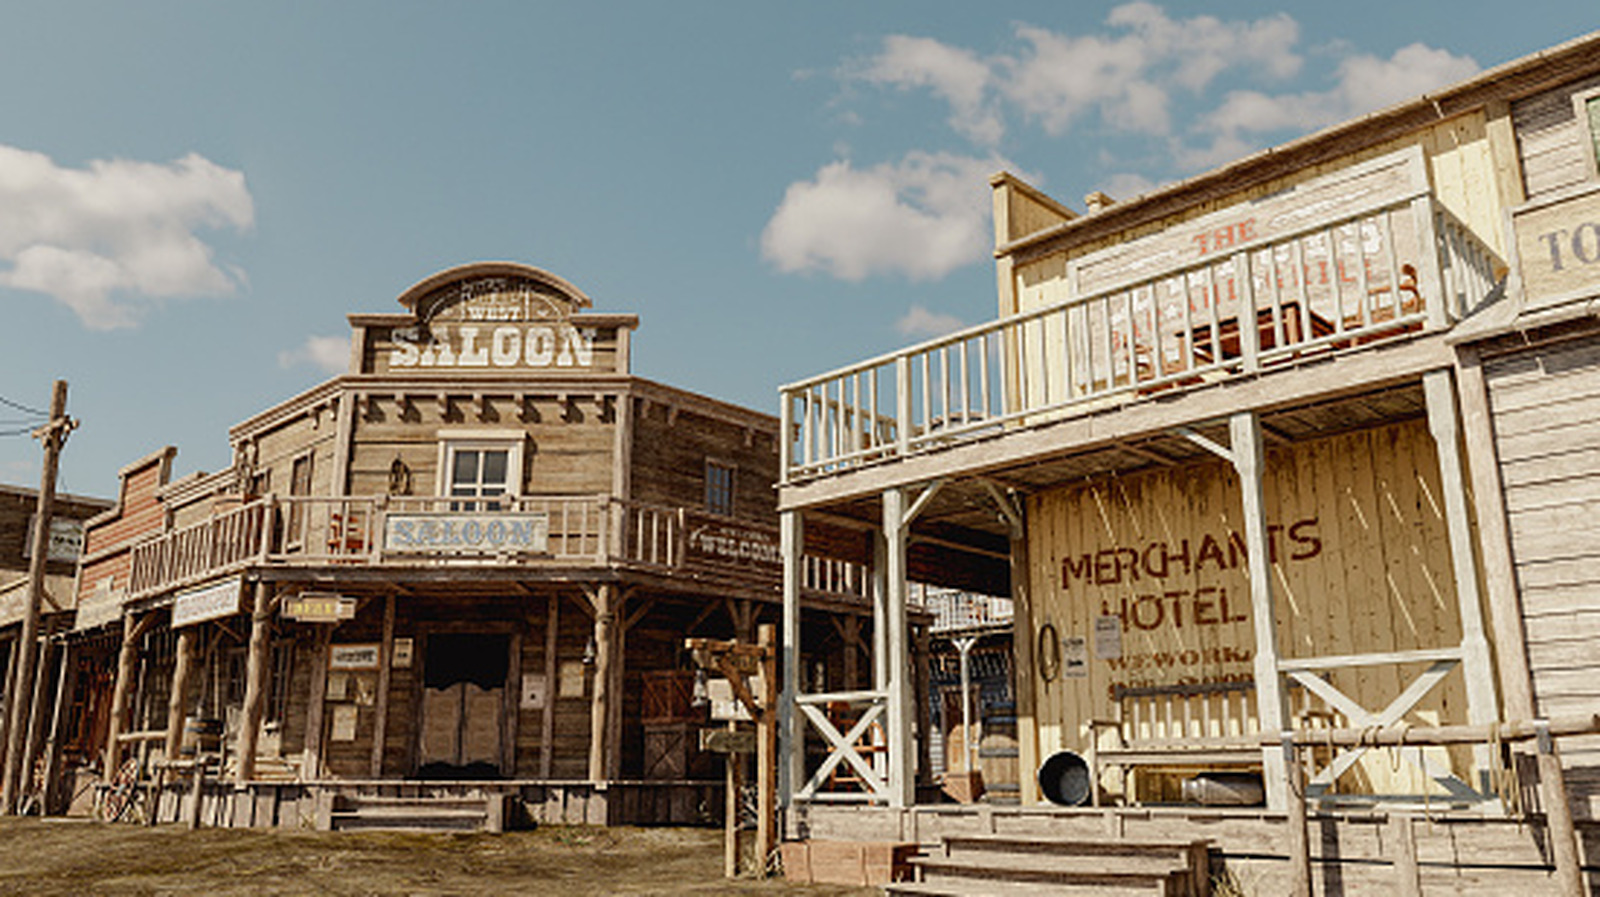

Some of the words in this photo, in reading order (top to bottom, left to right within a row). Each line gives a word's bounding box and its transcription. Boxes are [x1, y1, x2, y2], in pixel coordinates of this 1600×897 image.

[1192, 217, 1258, 255] THE
[1538, 222, 1600, 270] TO
[389, 326, 597, 367] SALOON
[392, 519, 534, 546] SALOON
[699, 533, 784, 564] WELCOM
[1062, 517, 1322, 590] MERCHANTS
[1101, 587, 1247, 633] HOTEL
